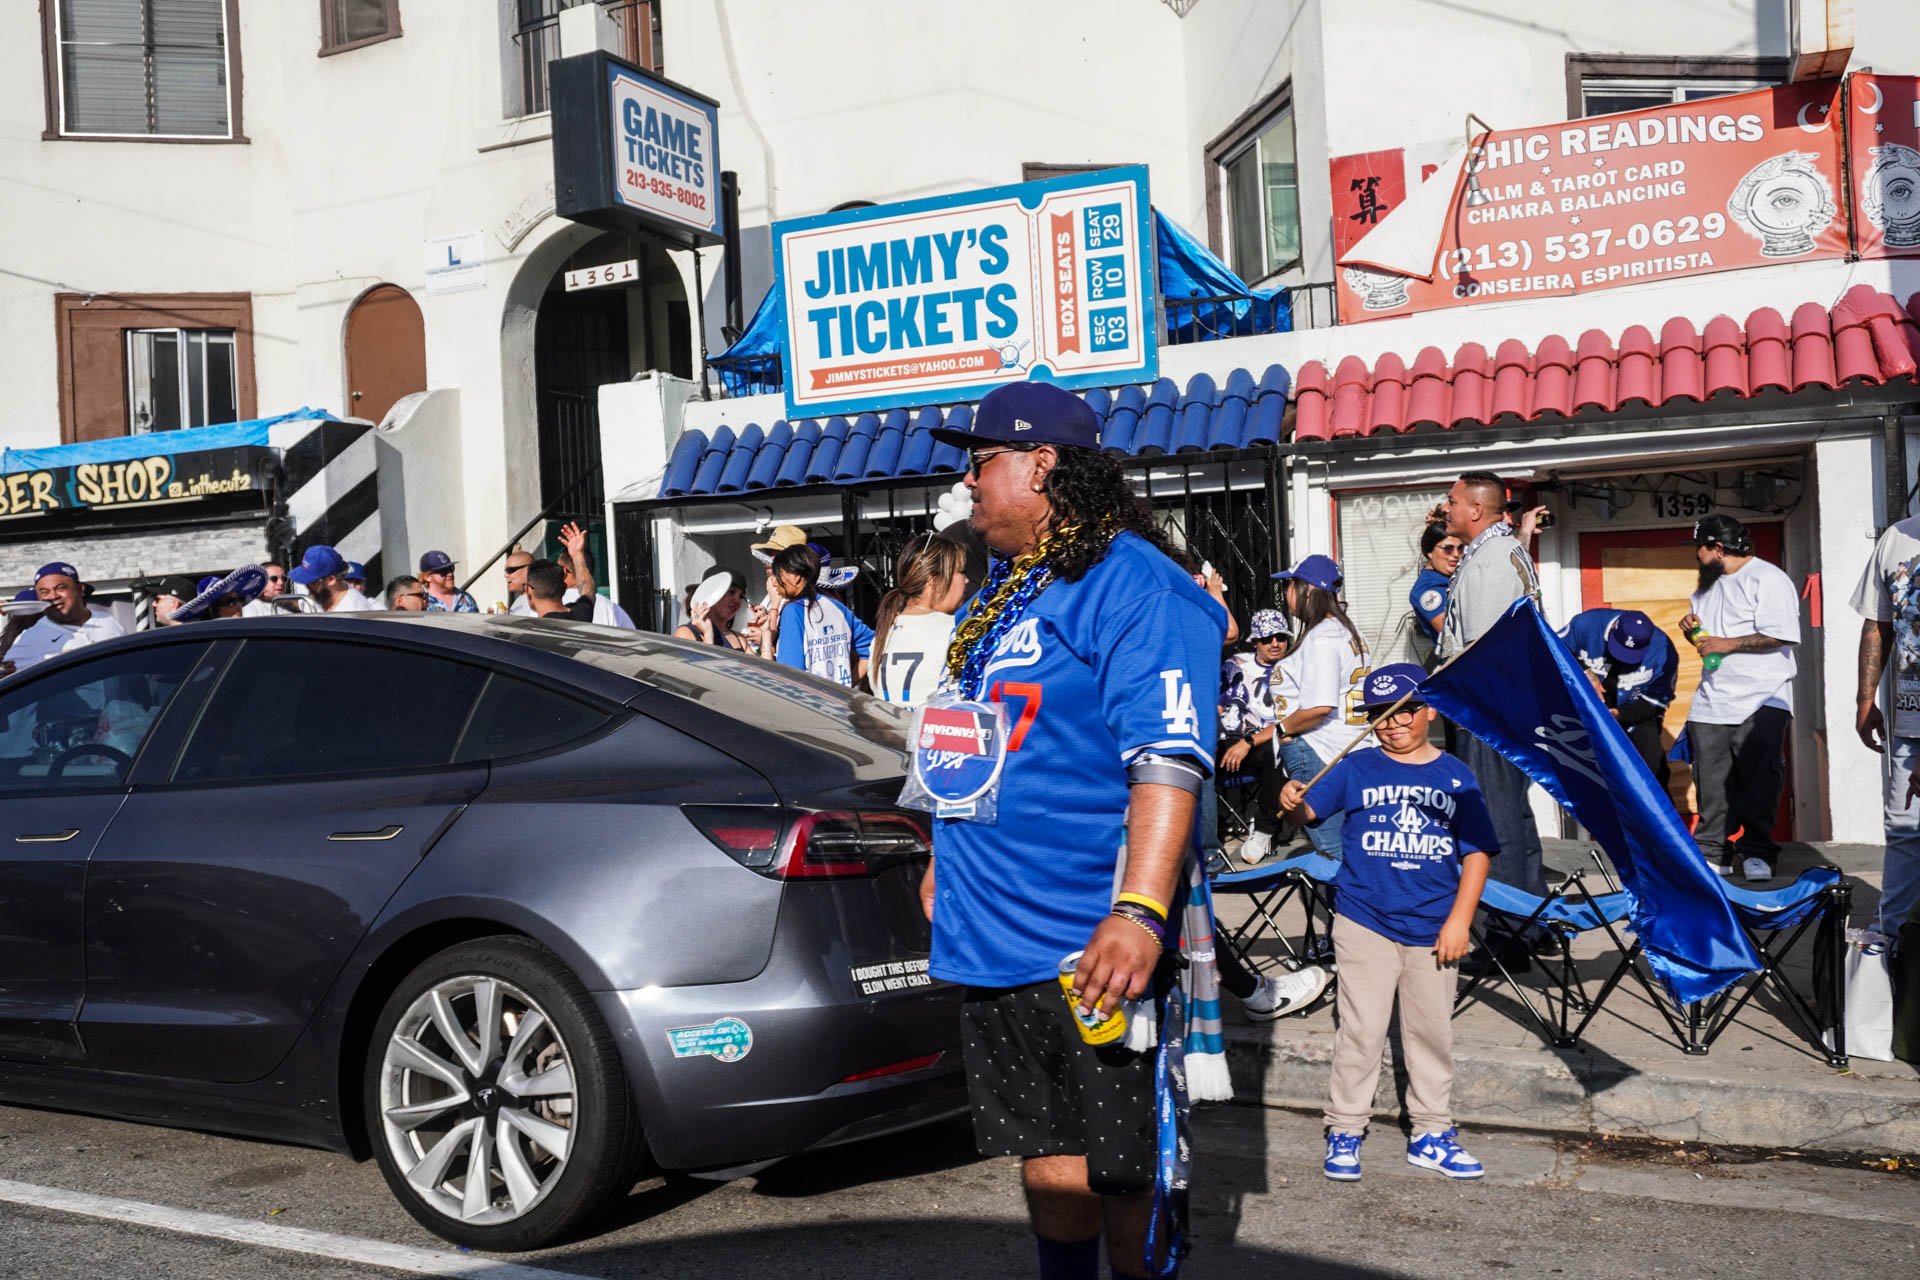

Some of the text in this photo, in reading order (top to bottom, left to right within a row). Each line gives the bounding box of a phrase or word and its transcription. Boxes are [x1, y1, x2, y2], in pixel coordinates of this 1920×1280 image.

[622, 97, 703, 162] GAME
[1560, 114, 1765, 157] READINGS
[624, 135, 704, 188] TICKETS
[626, 169, 706, 211] 213-935-8002
[1467, 160, 1685, 203] ALM & TAROT CARD
[1468, 180, 1686, 225] CHAKRA BALANCING
[1088, 209, 1101, 247] SEAT
[1102, 214, 1120, 240] 29
[1439, 212, 1727, 280] (213) 537-0629
[447, 245, 462, 266] L
[804, 224, 1009, 299] JIMMY'S
[569, 263, 632, 287] 1361
[1057, 232, 1075, 338] BOX SEATS
[1091, 260, 1104, 298] ROW
[1105, 267, 1123, 288] 10
[1453, 251, 1714, 299] CONSEJERA ESPIRITISTA
[808, 283, 1018, 359] TICKETS
[1094, 315, 1106, 345] SEC
[1108, 316, 1126, 342] 03
[825, 356, 984, 384] JIMMYSTICKETS@YAHOO.COM
[77, 455, 170, 504] SHOP
[1657, 494, 1710, 518] 1359
[1160, 669, 1200, 740] LA
[1362, 785, 1456, 819] DIVISION
[1369, 815, 1386, 823] 20
[1398, 800, 1422, 833] LA
[1362, 831, 1453, 856] CHAMPS
[856, 964, 887, 980] BOUGHT
[886, 962, 905, 975] THIS
[861, 974, 931, 995] ELON WENT CRAZY
